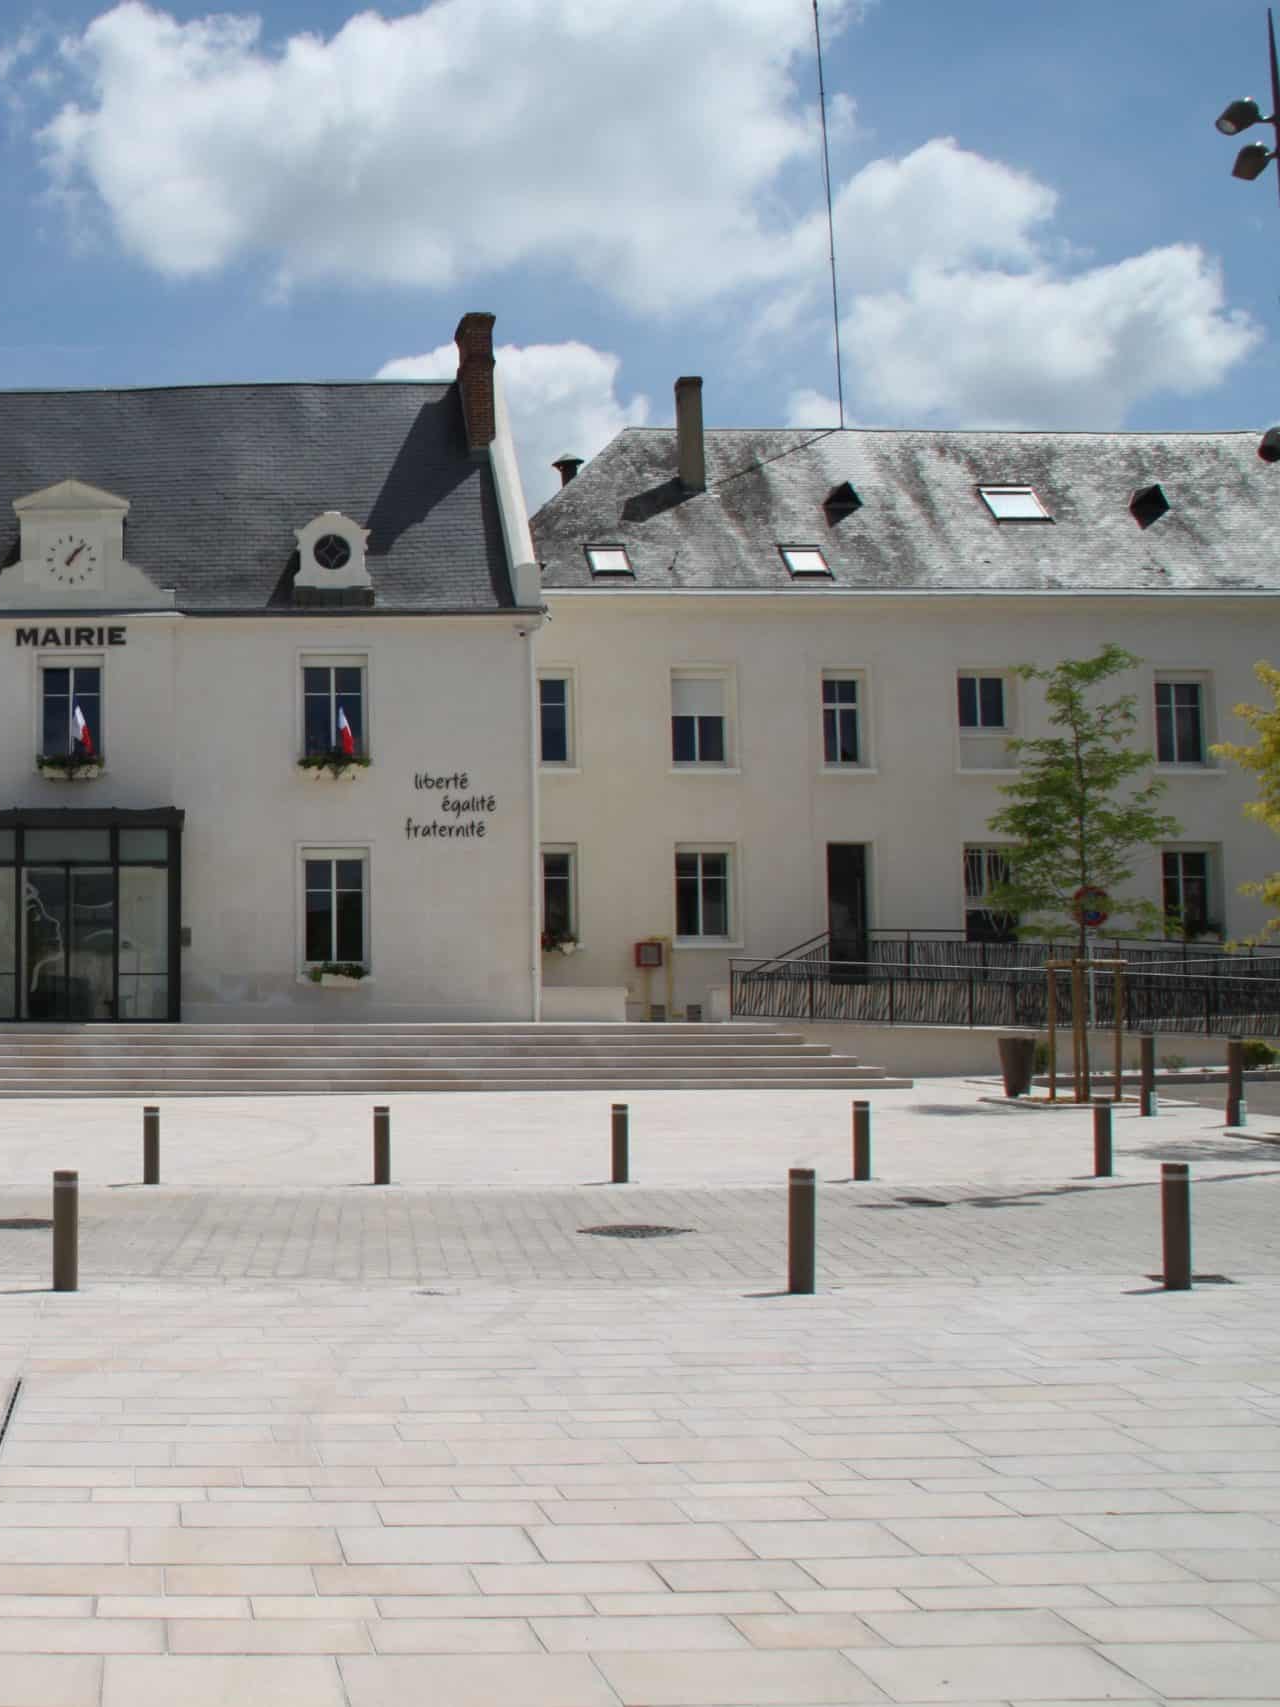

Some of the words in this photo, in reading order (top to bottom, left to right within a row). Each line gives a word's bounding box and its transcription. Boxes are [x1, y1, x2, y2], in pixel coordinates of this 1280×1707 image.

[15, 626, 127, 647] MAIRIE
[414, 772, 468, 790] liberté
[441, 795, 496, 819] égalité
[405, 817, 486, 840] fraternité
